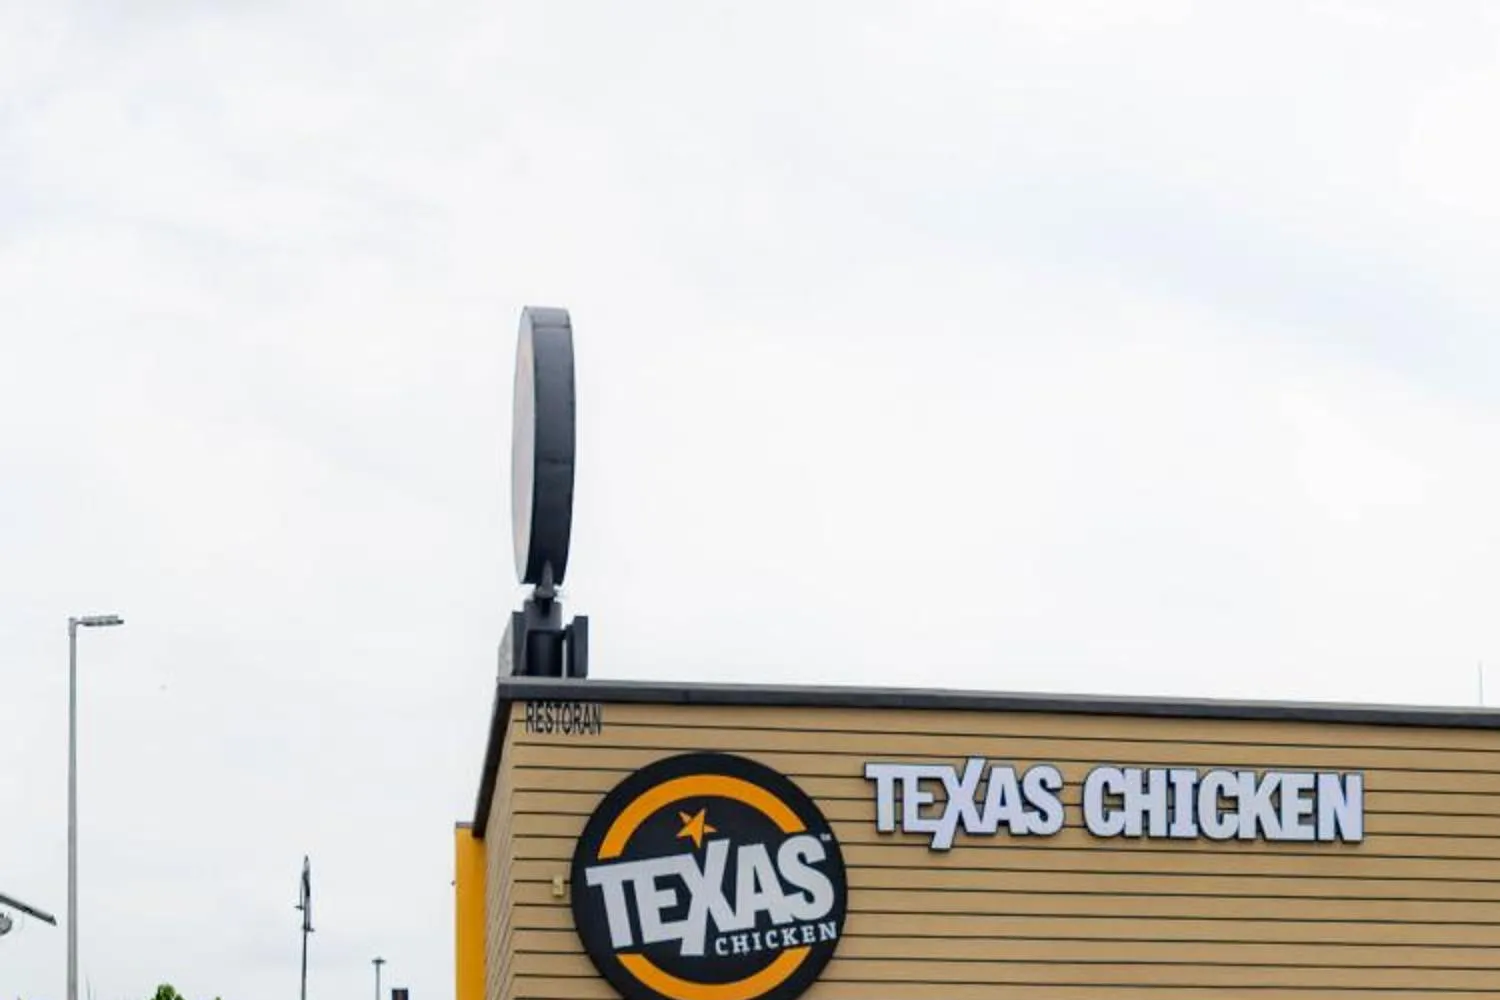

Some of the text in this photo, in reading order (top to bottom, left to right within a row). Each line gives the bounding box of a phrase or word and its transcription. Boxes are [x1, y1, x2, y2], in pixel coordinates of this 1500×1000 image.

[525, 702, 602, 735] RESTORAN
[864, 756, 1364, 851] TEXAS CHICKEN
[584, 834, 835, 956] TEXAS
[714, 921, 838, 955] CHICKEN
